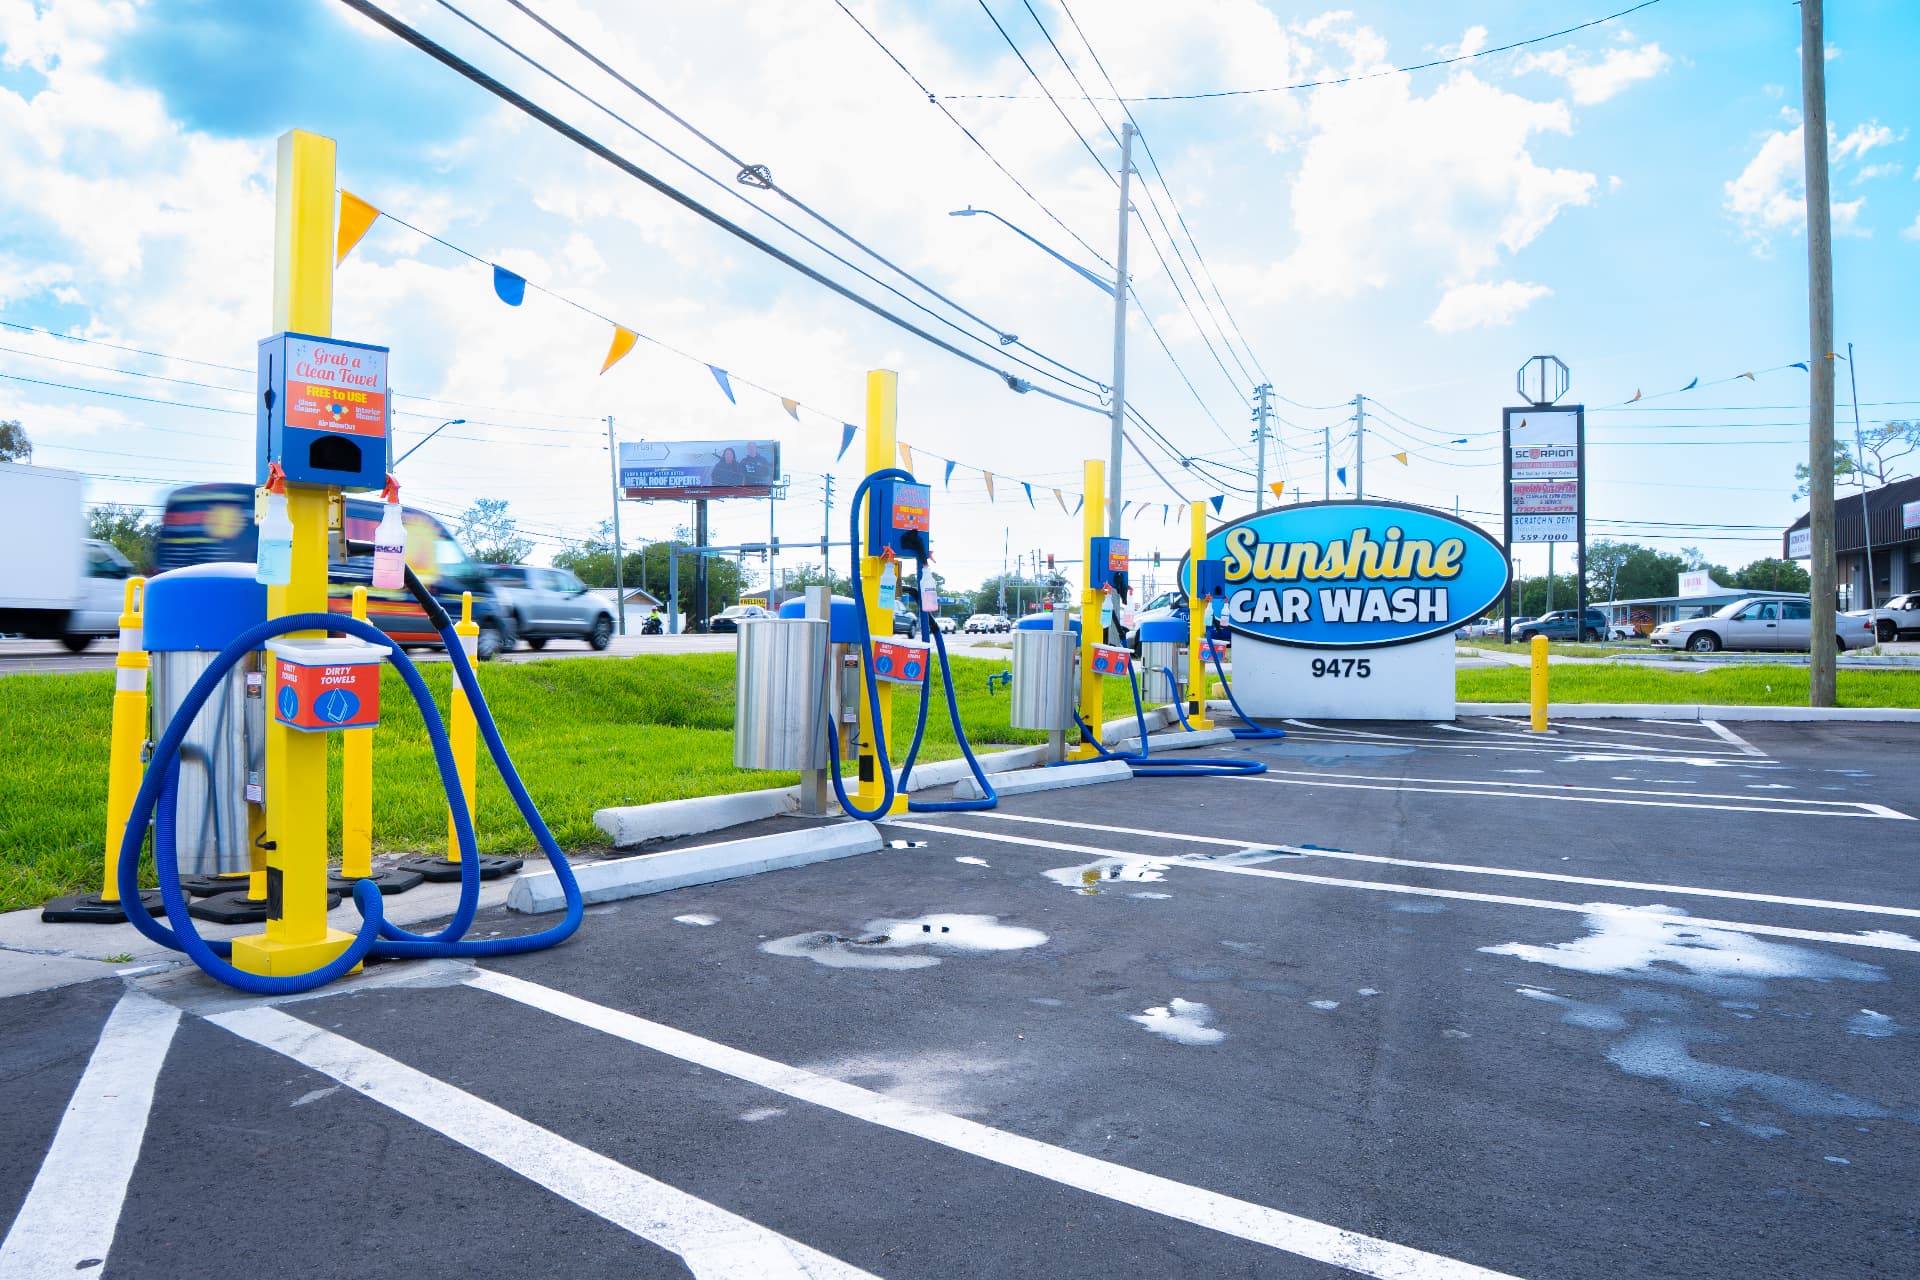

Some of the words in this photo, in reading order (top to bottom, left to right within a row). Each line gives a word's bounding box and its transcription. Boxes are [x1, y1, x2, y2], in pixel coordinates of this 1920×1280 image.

[314, 347, 349, 367] Grab
[352, 358, 361, 369] a
[296, 361, 335, 381] Clean
[339, 368, 378, 387] Towel
[306, 385, 330, 398] FREE
[333, 389, 345, 400] to
[347, 392, 367, 403] USE
[624, 477, 648, 486] METAL
[649, 477, 668, 486] ROOF
[669, 476, 701, 486] EXPERTS
[1556, 516, 1576, 524] DENT
[1520, 533, 1569, 541] 559-7000
[1222, 526, 1467, 584] Sunshine
[1227, 587, 1311, 623] CAR
[1318, 586, 1449, 623] WASH
[283, 664, 296, 673] DIRTY
[325, 667, 352, 676] DIRTY
[1311, 659, 1371, 679] 9475
[281, 671, 298, 683] TOWELS
[320, 675, 356, 685] TOWELS
